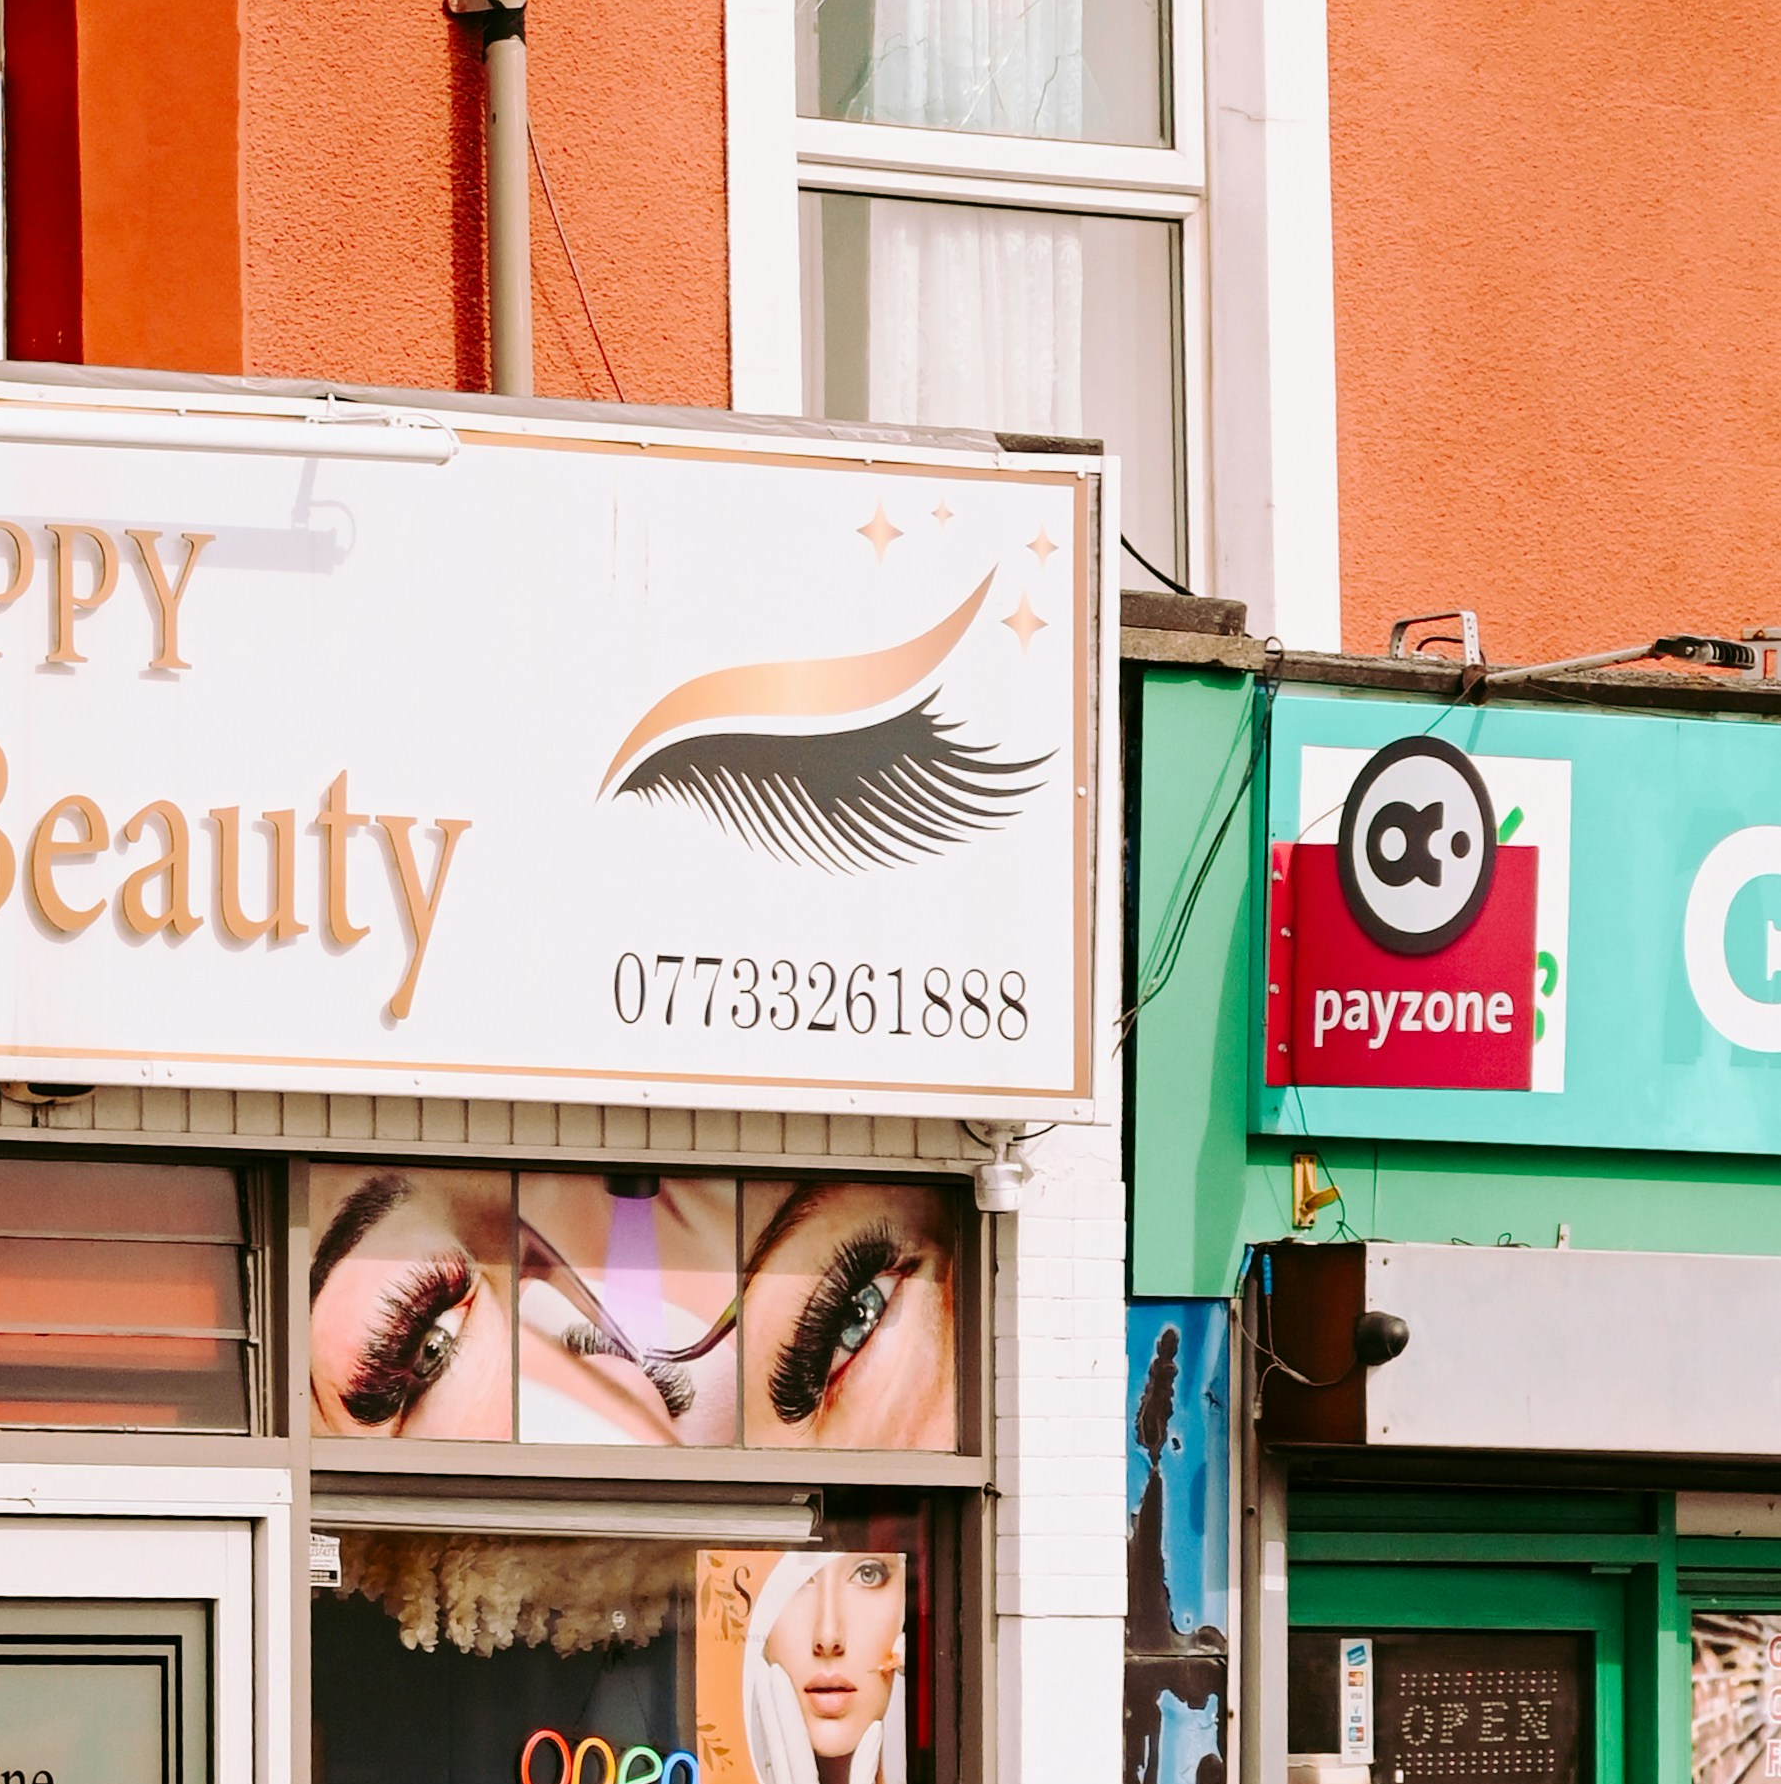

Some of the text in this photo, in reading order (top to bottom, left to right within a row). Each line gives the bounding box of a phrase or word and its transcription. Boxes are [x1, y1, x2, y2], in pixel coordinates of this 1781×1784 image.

[613, 951, 1029, 1042] 07733261888
[1313, 987, 1514, 1049] payzone
[1401, 1699, 1553, 1747] OPEN
